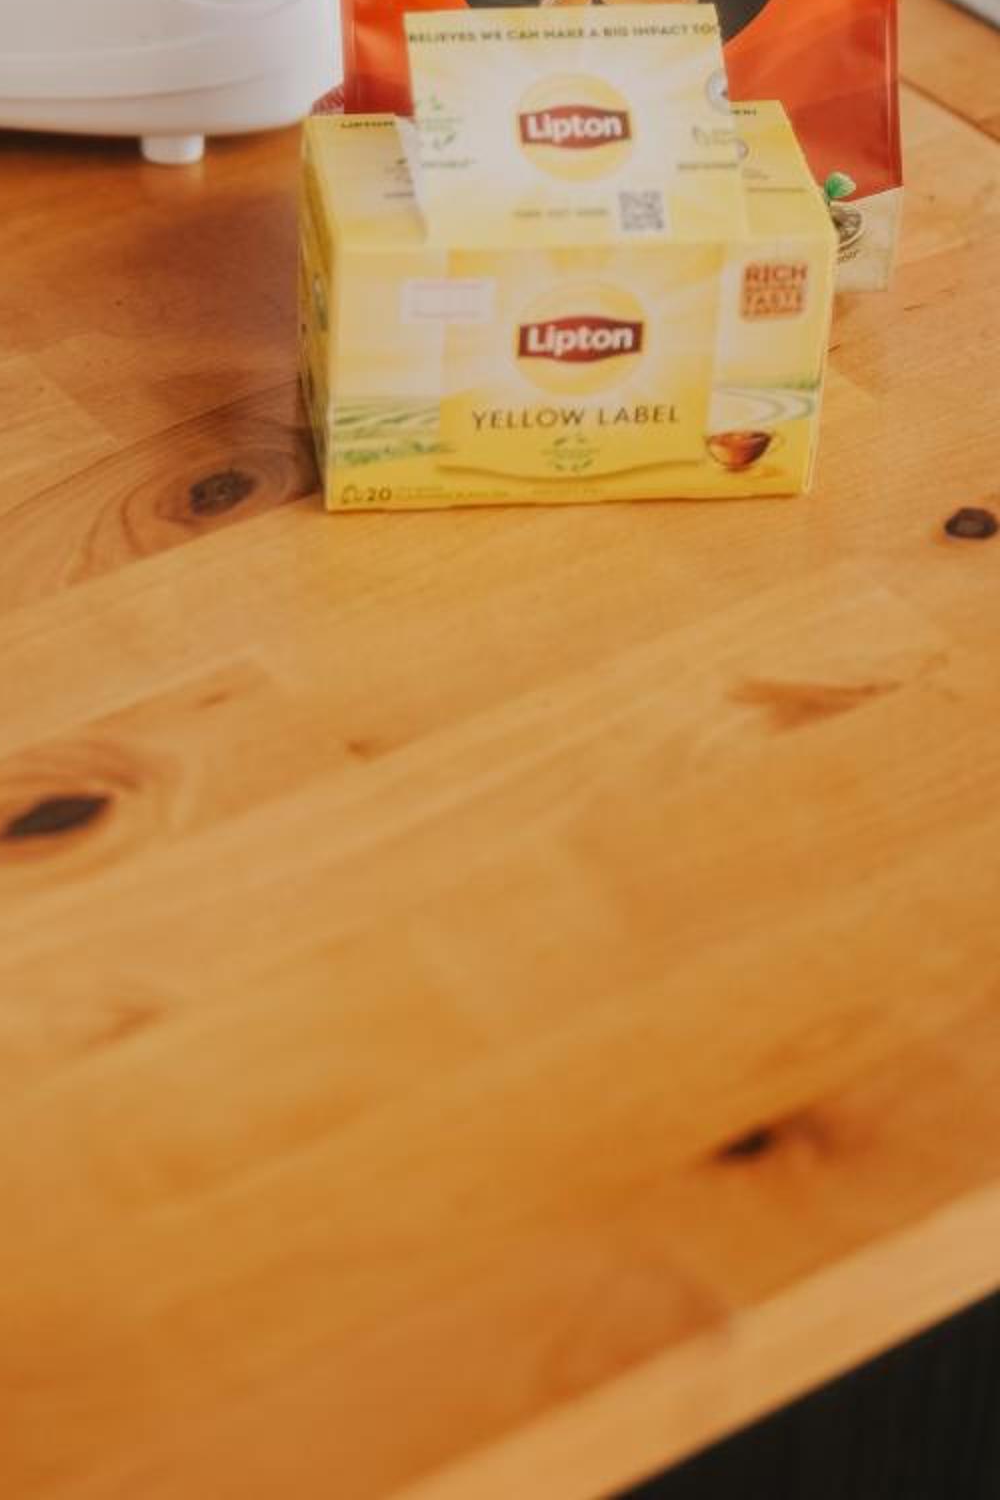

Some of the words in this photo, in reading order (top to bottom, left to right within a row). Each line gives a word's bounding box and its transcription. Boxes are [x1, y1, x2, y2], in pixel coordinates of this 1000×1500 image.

[506, 28, 540, 41] CAN
[634, 23, 688, 38] IMPACT
[526, 113, 622, 143] Lipton
[744, 263, 808, 284] RICH
[527, 323, 633, 357] Lipton
[471, 409, 585, 431] YELLOW
[599, 404, 681, 425] LABEL
[366, 486, 392, 502] 20
